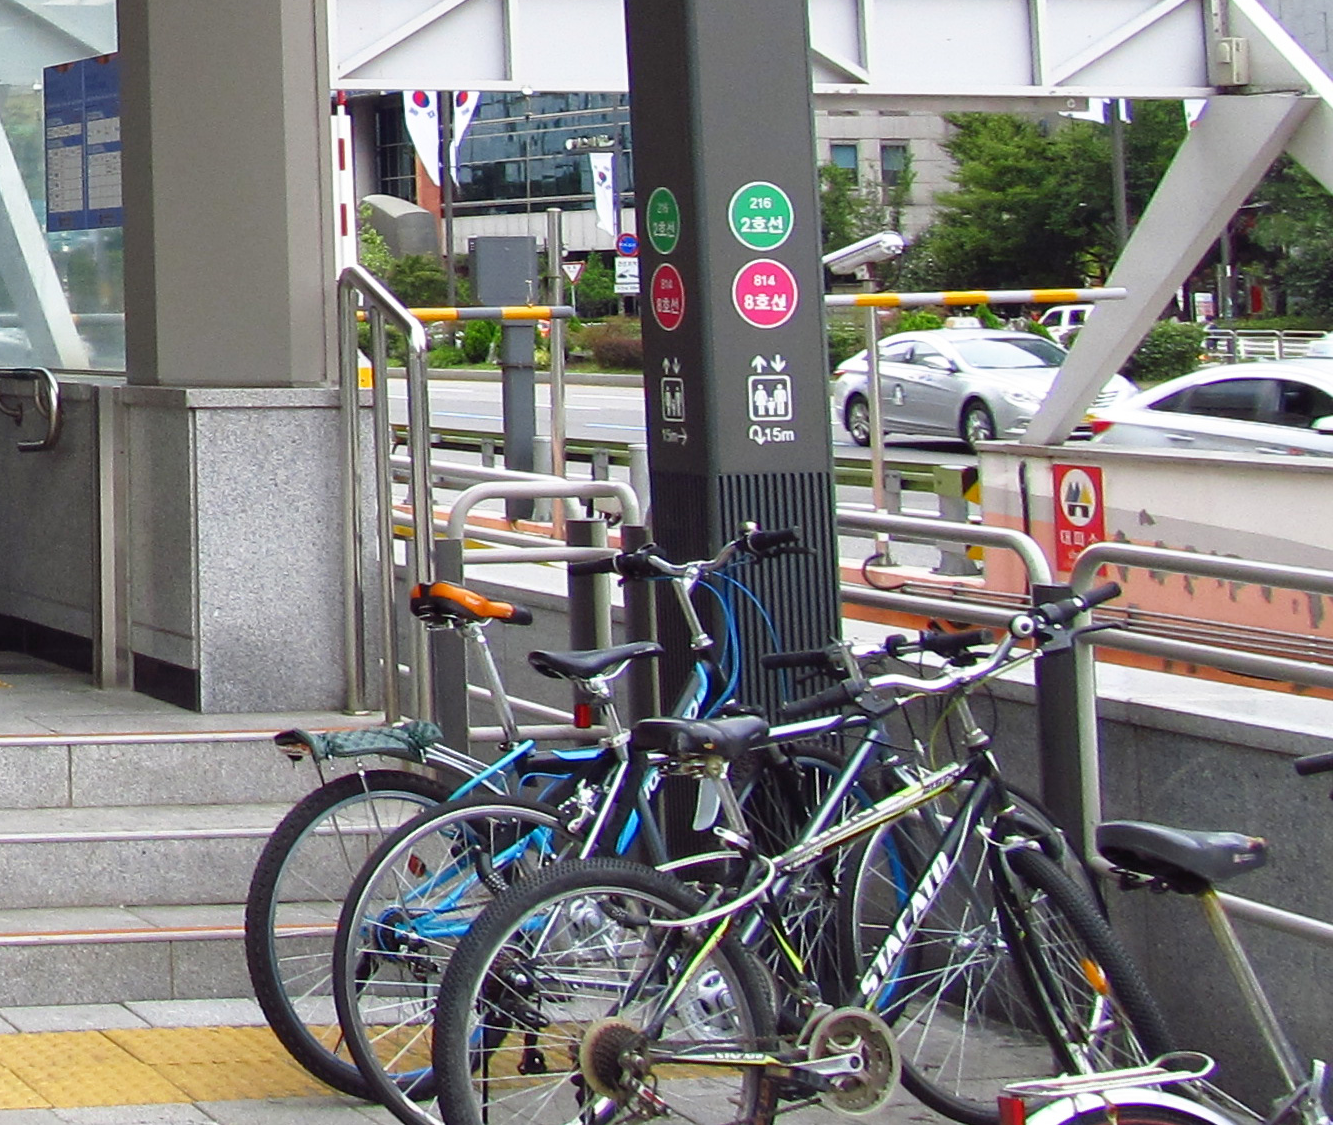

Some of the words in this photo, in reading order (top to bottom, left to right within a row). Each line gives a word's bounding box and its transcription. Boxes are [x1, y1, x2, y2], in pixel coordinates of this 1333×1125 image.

[749, 197, 771, 209] 216
[740, 216, 784, 235] 2호선
[753, 274, 776, 287] 814
[743, 293, 787, 313] 8호선
[765, 427, 795, 443] 15m
